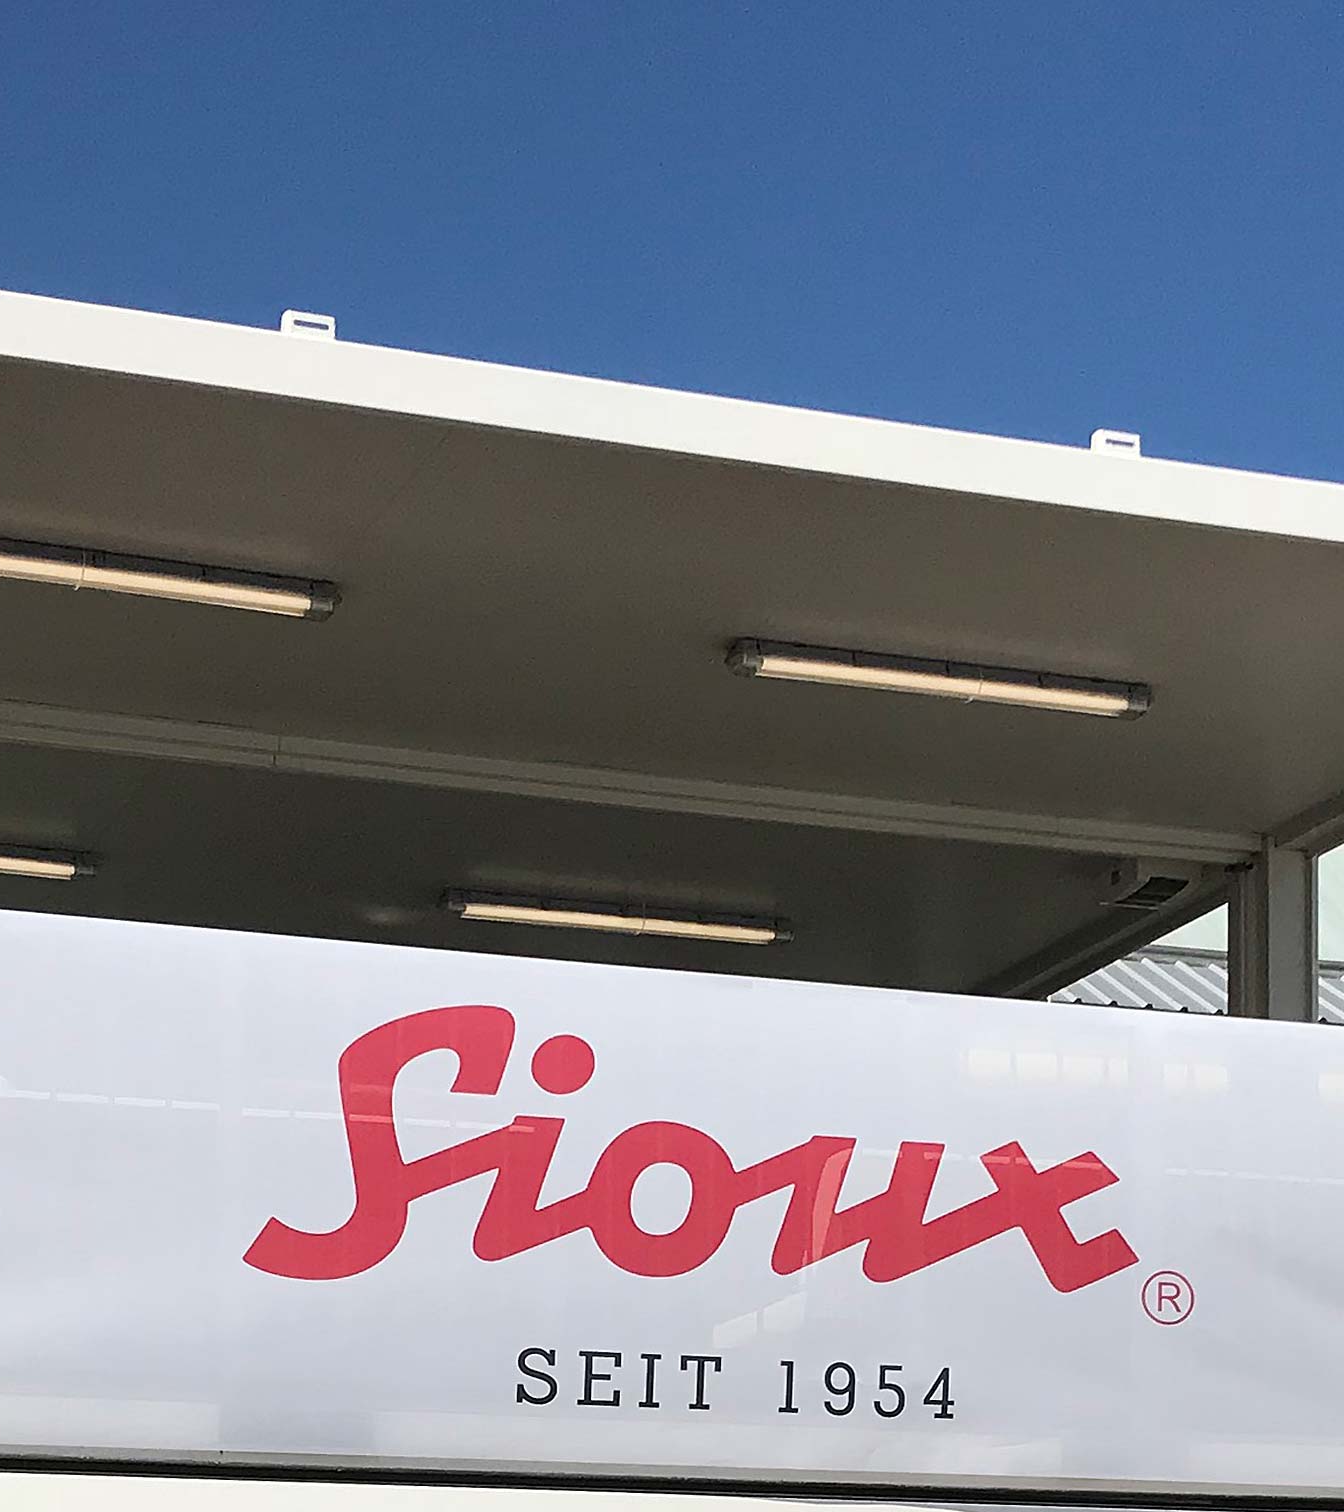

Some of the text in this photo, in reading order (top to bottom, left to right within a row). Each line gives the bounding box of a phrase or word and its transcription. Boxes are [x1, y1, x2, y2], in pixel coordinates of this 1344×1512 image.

[243, 1005, 1140, 1293] Sioux
[516, 1347, 955, 1419] SEIT 1954
